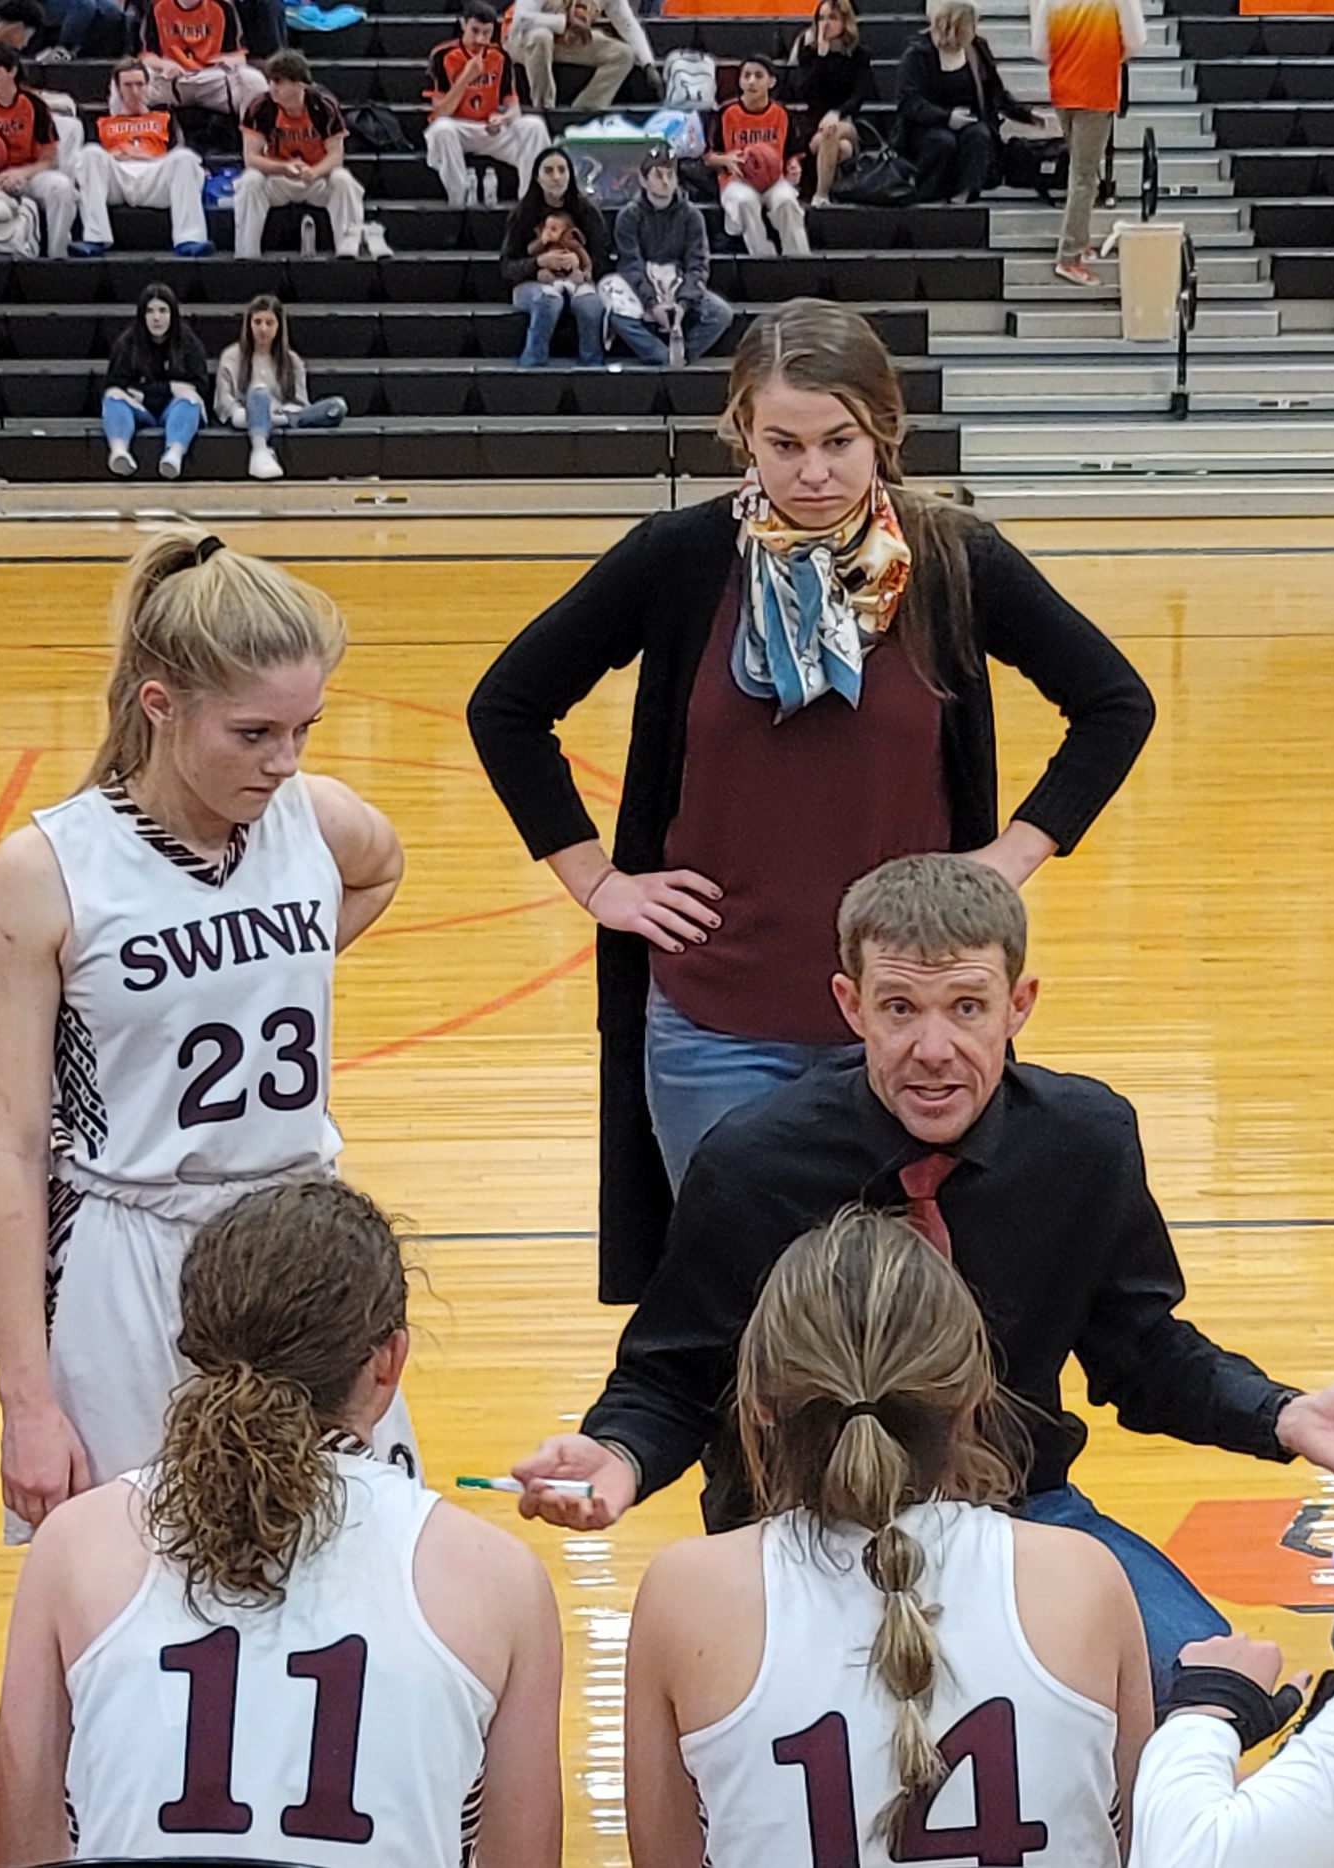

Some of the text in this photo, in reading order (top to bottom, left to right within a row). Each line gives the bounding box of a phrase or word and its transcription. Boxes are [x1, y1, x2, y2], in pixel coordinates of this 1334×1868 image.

[119, 899, 330, 992] SWINK
[177, 1006, 319, 1129] 23
[158, 1625, 375, 1845] 11
[772, 1697, 1049, 1868] 14
